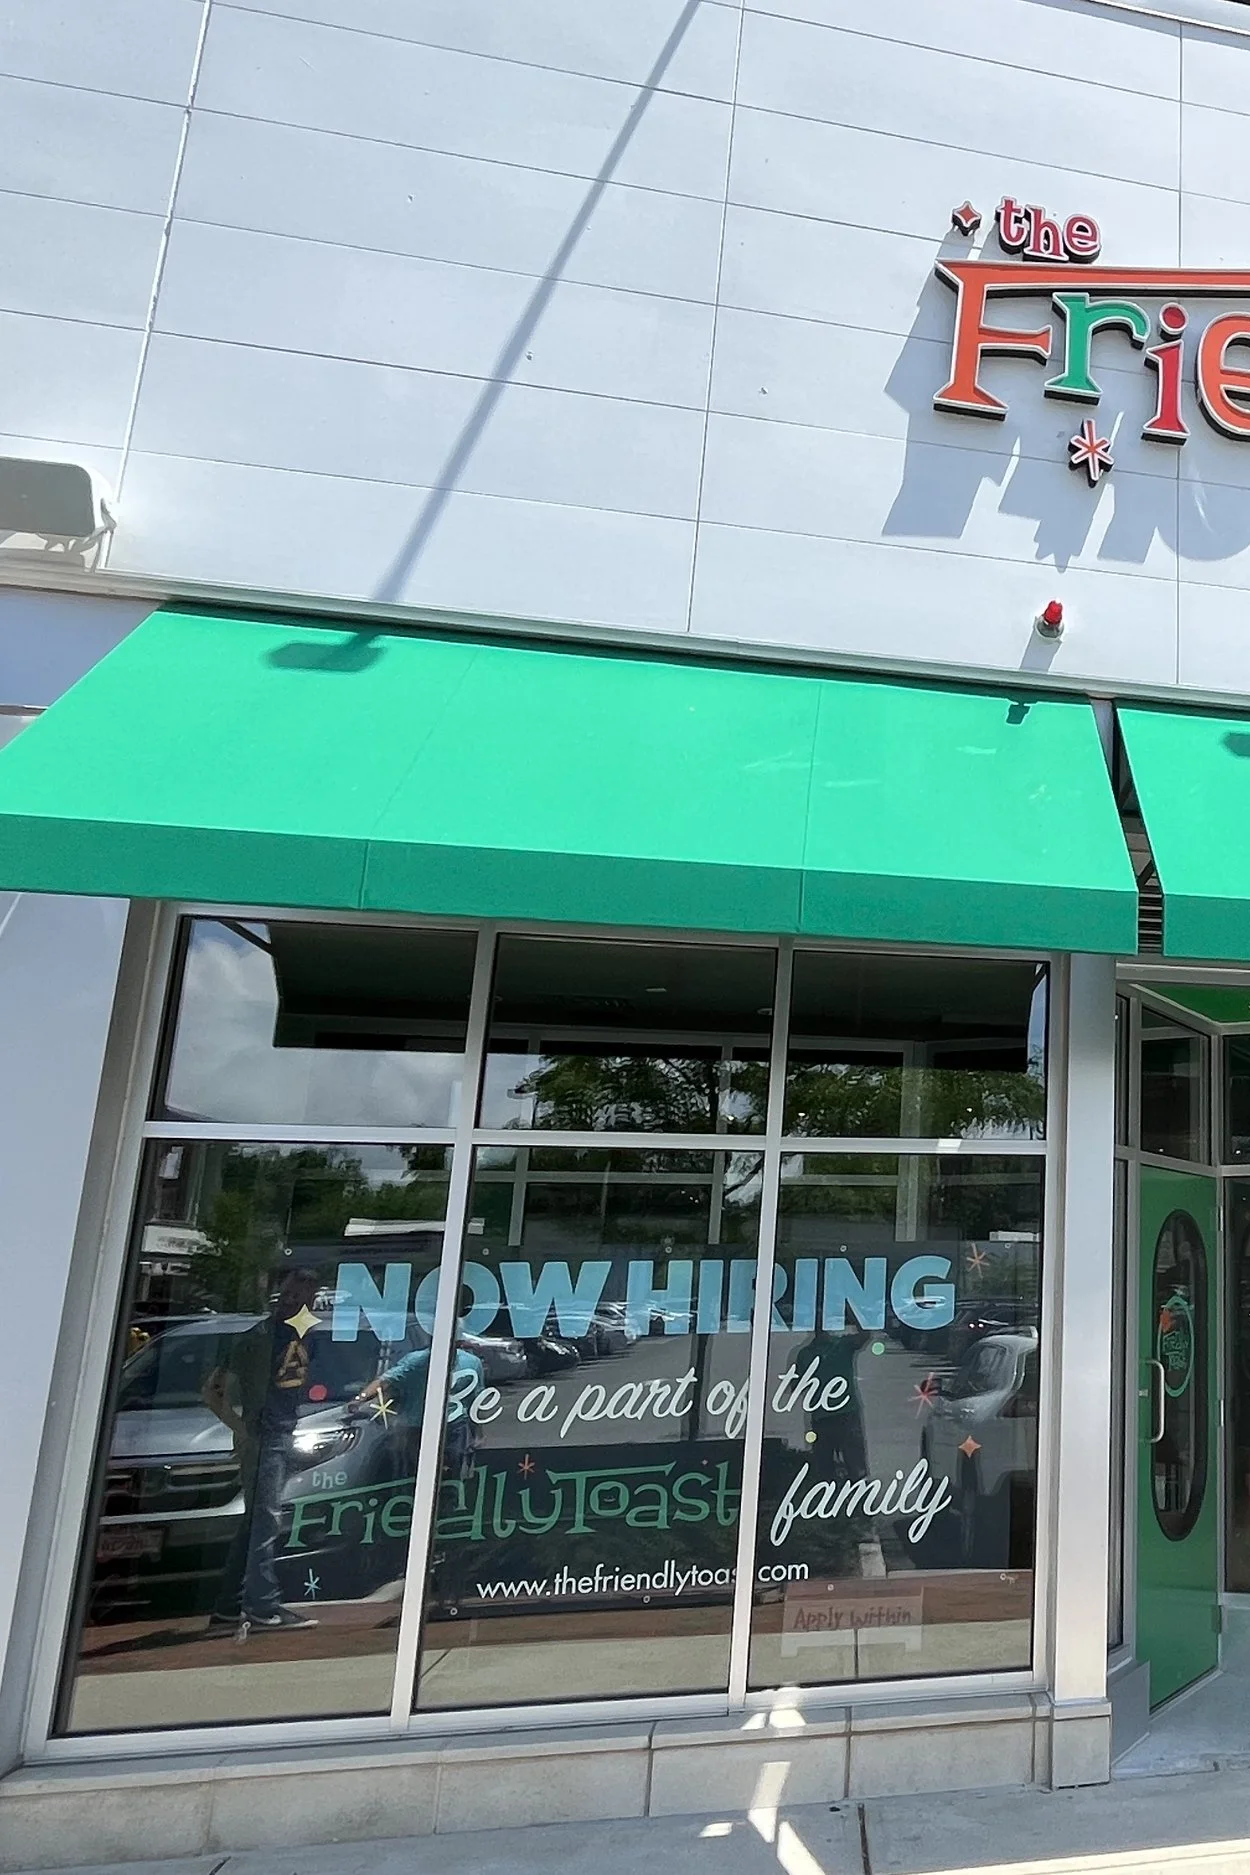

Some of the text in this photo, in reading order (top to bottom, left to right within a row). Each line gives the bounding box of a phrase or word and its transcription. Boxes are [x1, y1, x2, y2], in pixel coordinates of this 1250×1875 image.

[997, 196, 1101, 262] the
[331, 1255, 956, 1342] NOW HIRING
[516, 1384, 560, 1423] a
[559, 1367, 698, 1440] part
[706, 1378, 751, 1440] of
[771, 1355, 851, 1413] the
[310, 1469, 348, 1489] the
[769, 1457, 953, 1548] family
[476, 1558, 810, 1600] www.thefriendlytoacom
[792, 1606, 844, 1632] Apply
